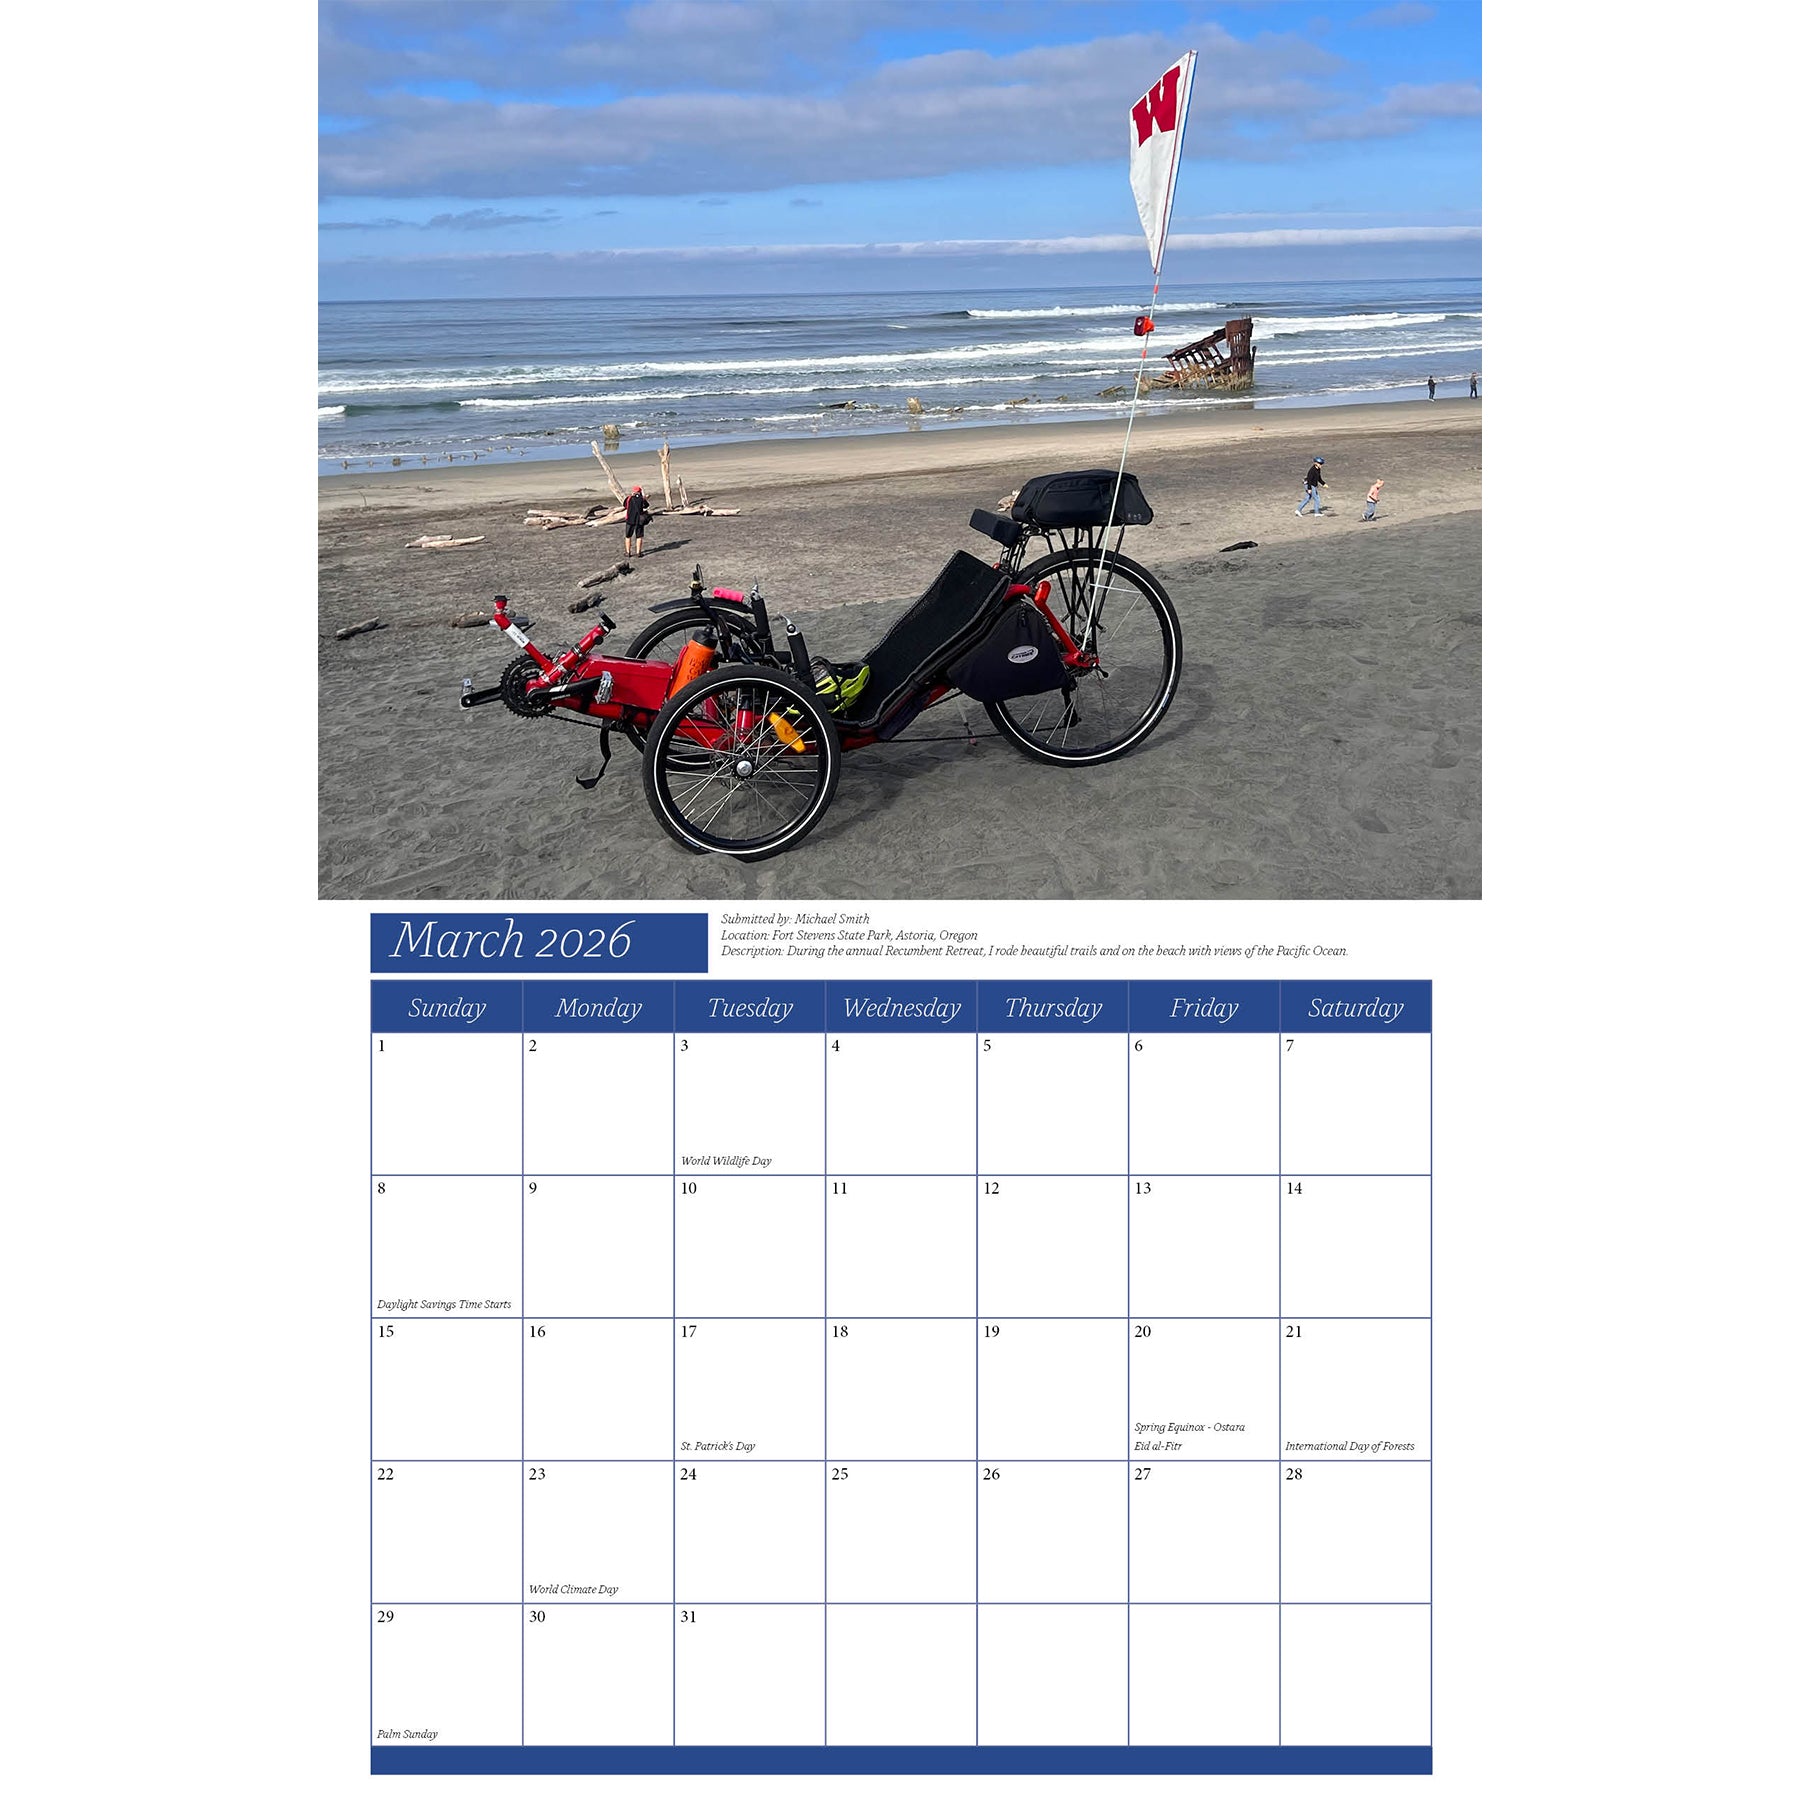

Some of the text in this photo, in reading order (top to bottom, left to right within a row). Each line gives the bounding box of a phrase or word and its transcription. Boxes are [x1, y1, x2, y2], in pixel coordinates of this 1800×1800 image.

[1132, 65, 1181, 147] W
[720, 913, 870, 927] Submitted by: Michael Smith
[389, 917, 636, 958] March 2026
[721, 929, 978, 943] Location: Fort Stevens State Park, Astoria, Oregon
[721, 945, 1349, 958] Description: During the annual Recumbent Retreat, I rode beautiful trails and on the beach with views of the Pacific Ocean.
[409, 996, 486, 1024] Sunday
[555, 996, 642, 1024] Monday
[709, 996, 793, 1024] Tuesday
[845, 996, 961, 1024] Wednesday
[1006, 996, 1102, 1024] Thursday
[1170, 996, 1239, 1024] Friday
[1309, 996, 1404, 1024] Saturday
[378, 1039, 385, 1053] 1
[528, 1038, 538, 1053] 2
[680, 1038, 689, 1052] 3
[831, 1039, 841, 1053] 4
[983, 1038, 992, 1053] 5
[1134, 1039, 1144, 1053] 6
[1285, 1038, 1295, 1053] 7
[682, 1155, 773, 1168] World Wildlife Day
[377, 1181, 386, 1195] 8
[528, 1181, 538, 1195] 9
[681, 1181, 698, 1195] 10
[832, 1181, 848, 1195] 11
[984, 1181, 1000, 1195] 12
[1135, 1181, 1152, 1195] 13
[1287, 1181, 1303, 1195] 14
[377, 1299, 512, 1311] Daylight Savings Time Starts
[378, 1324, 395, 1338] 15
[529, 1324, 546, 1338] 16
[681, 1324, 698, 1338] 17
[832, 1324, 849, 1338] 18
[984, 1324, 1001, 1338] 19
[1134, 1324, 1152, 1338] 20
[1285, 1324, 1302, 1338] 21
[1134, 1422, 1166, 1435] Spring
[1167, 1422, 1206, 1435] Equinox
[1213, 1422, 1245, 1432] Ostara
[681, 1441, 693, 1451] St.
[736, 1441, 756, 1454] Day
[1134, 1440, 1182, 1451] Eid al-Fitr
[1285, 1440, 1415, 1454] International Day of Forests
[376, 1467, 395, 1481] 22
[528, 1467, 546, 1481] 23
[679, 1467, 697, 1481] 24
[831, 1467, 849, 1481] 25
[982, 1467, 1001, 1481] 26
[1134, 1467, 1152, 1481] 27
[1285, 1467, 1303, 1481] 28
[529, 1584, 619, 1597] World Climate Day
[376, 1609, 395, 1624] 29
[528, 1609, 546, 1624] 30
[680, 1609, 697, 1624] 31
[377, 1729, 438, 1742] Palm Sunday
